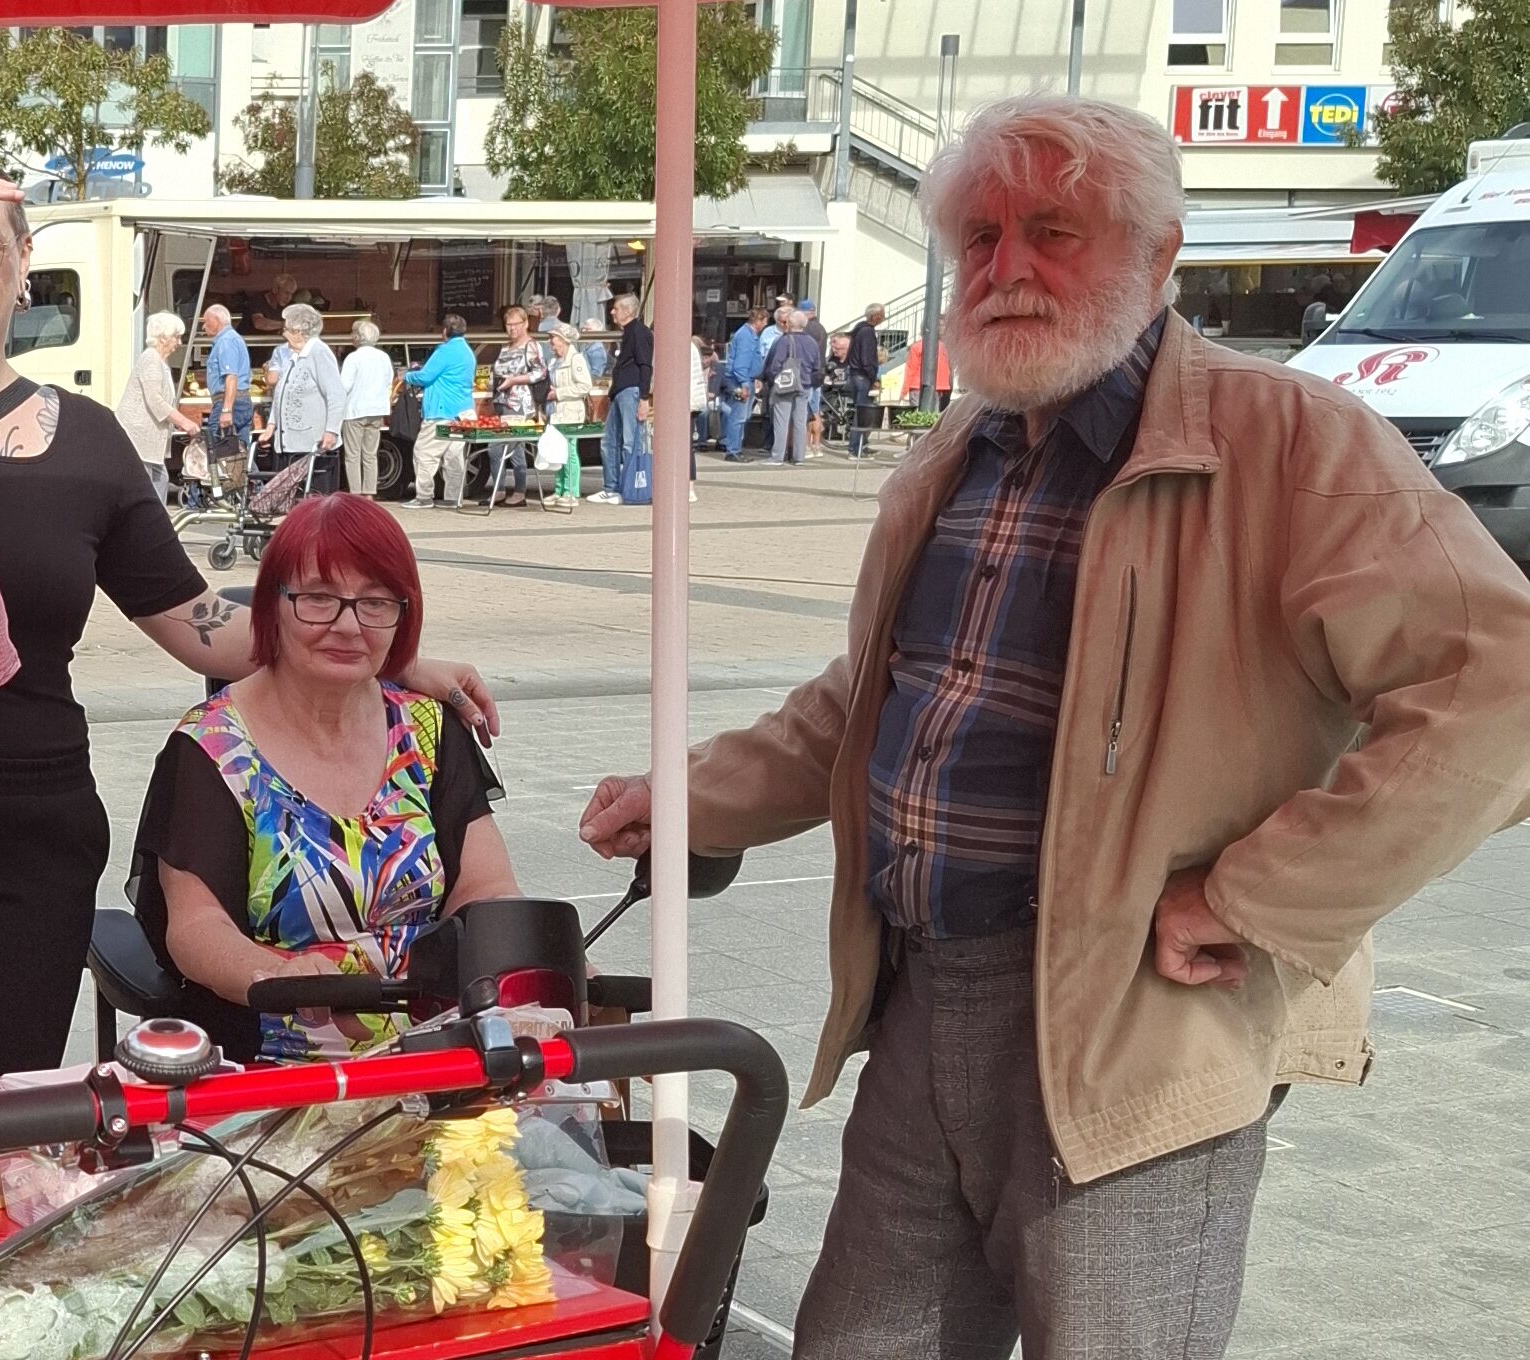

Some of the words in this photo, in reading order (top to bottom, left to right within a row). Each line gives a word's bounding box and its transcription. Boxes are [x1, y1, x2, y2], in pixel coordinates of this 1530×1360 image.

[1199, 90, 1242, 101] clever
[1199, 98, 1242, 130] fit
[1309, 105, 1358, 124] TEDi
